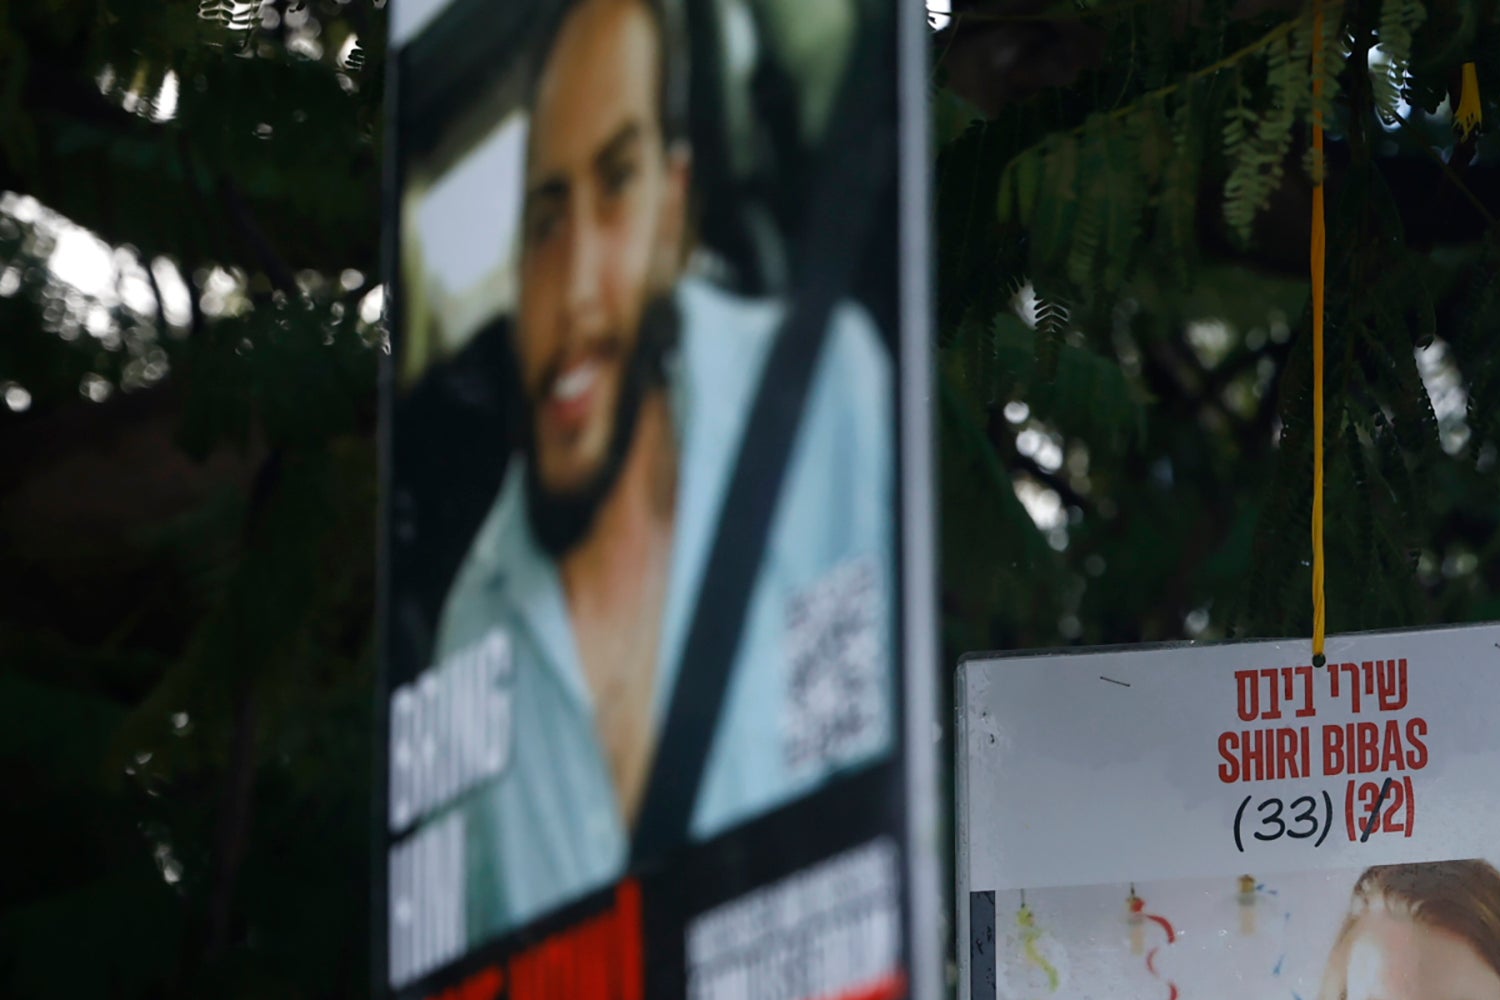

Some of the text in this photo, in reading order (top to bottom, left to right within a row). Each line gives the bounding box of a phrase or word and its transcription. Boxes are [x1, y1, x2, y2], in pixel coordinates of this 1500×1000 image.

[1235, 658, 1408, 721] שירי ביבס
[1218, 718, 1428, 783] SHIRI BIBAS
[1233, 790, 1333, 852] (33)
[1345, 776, 1414, 841] (32)
